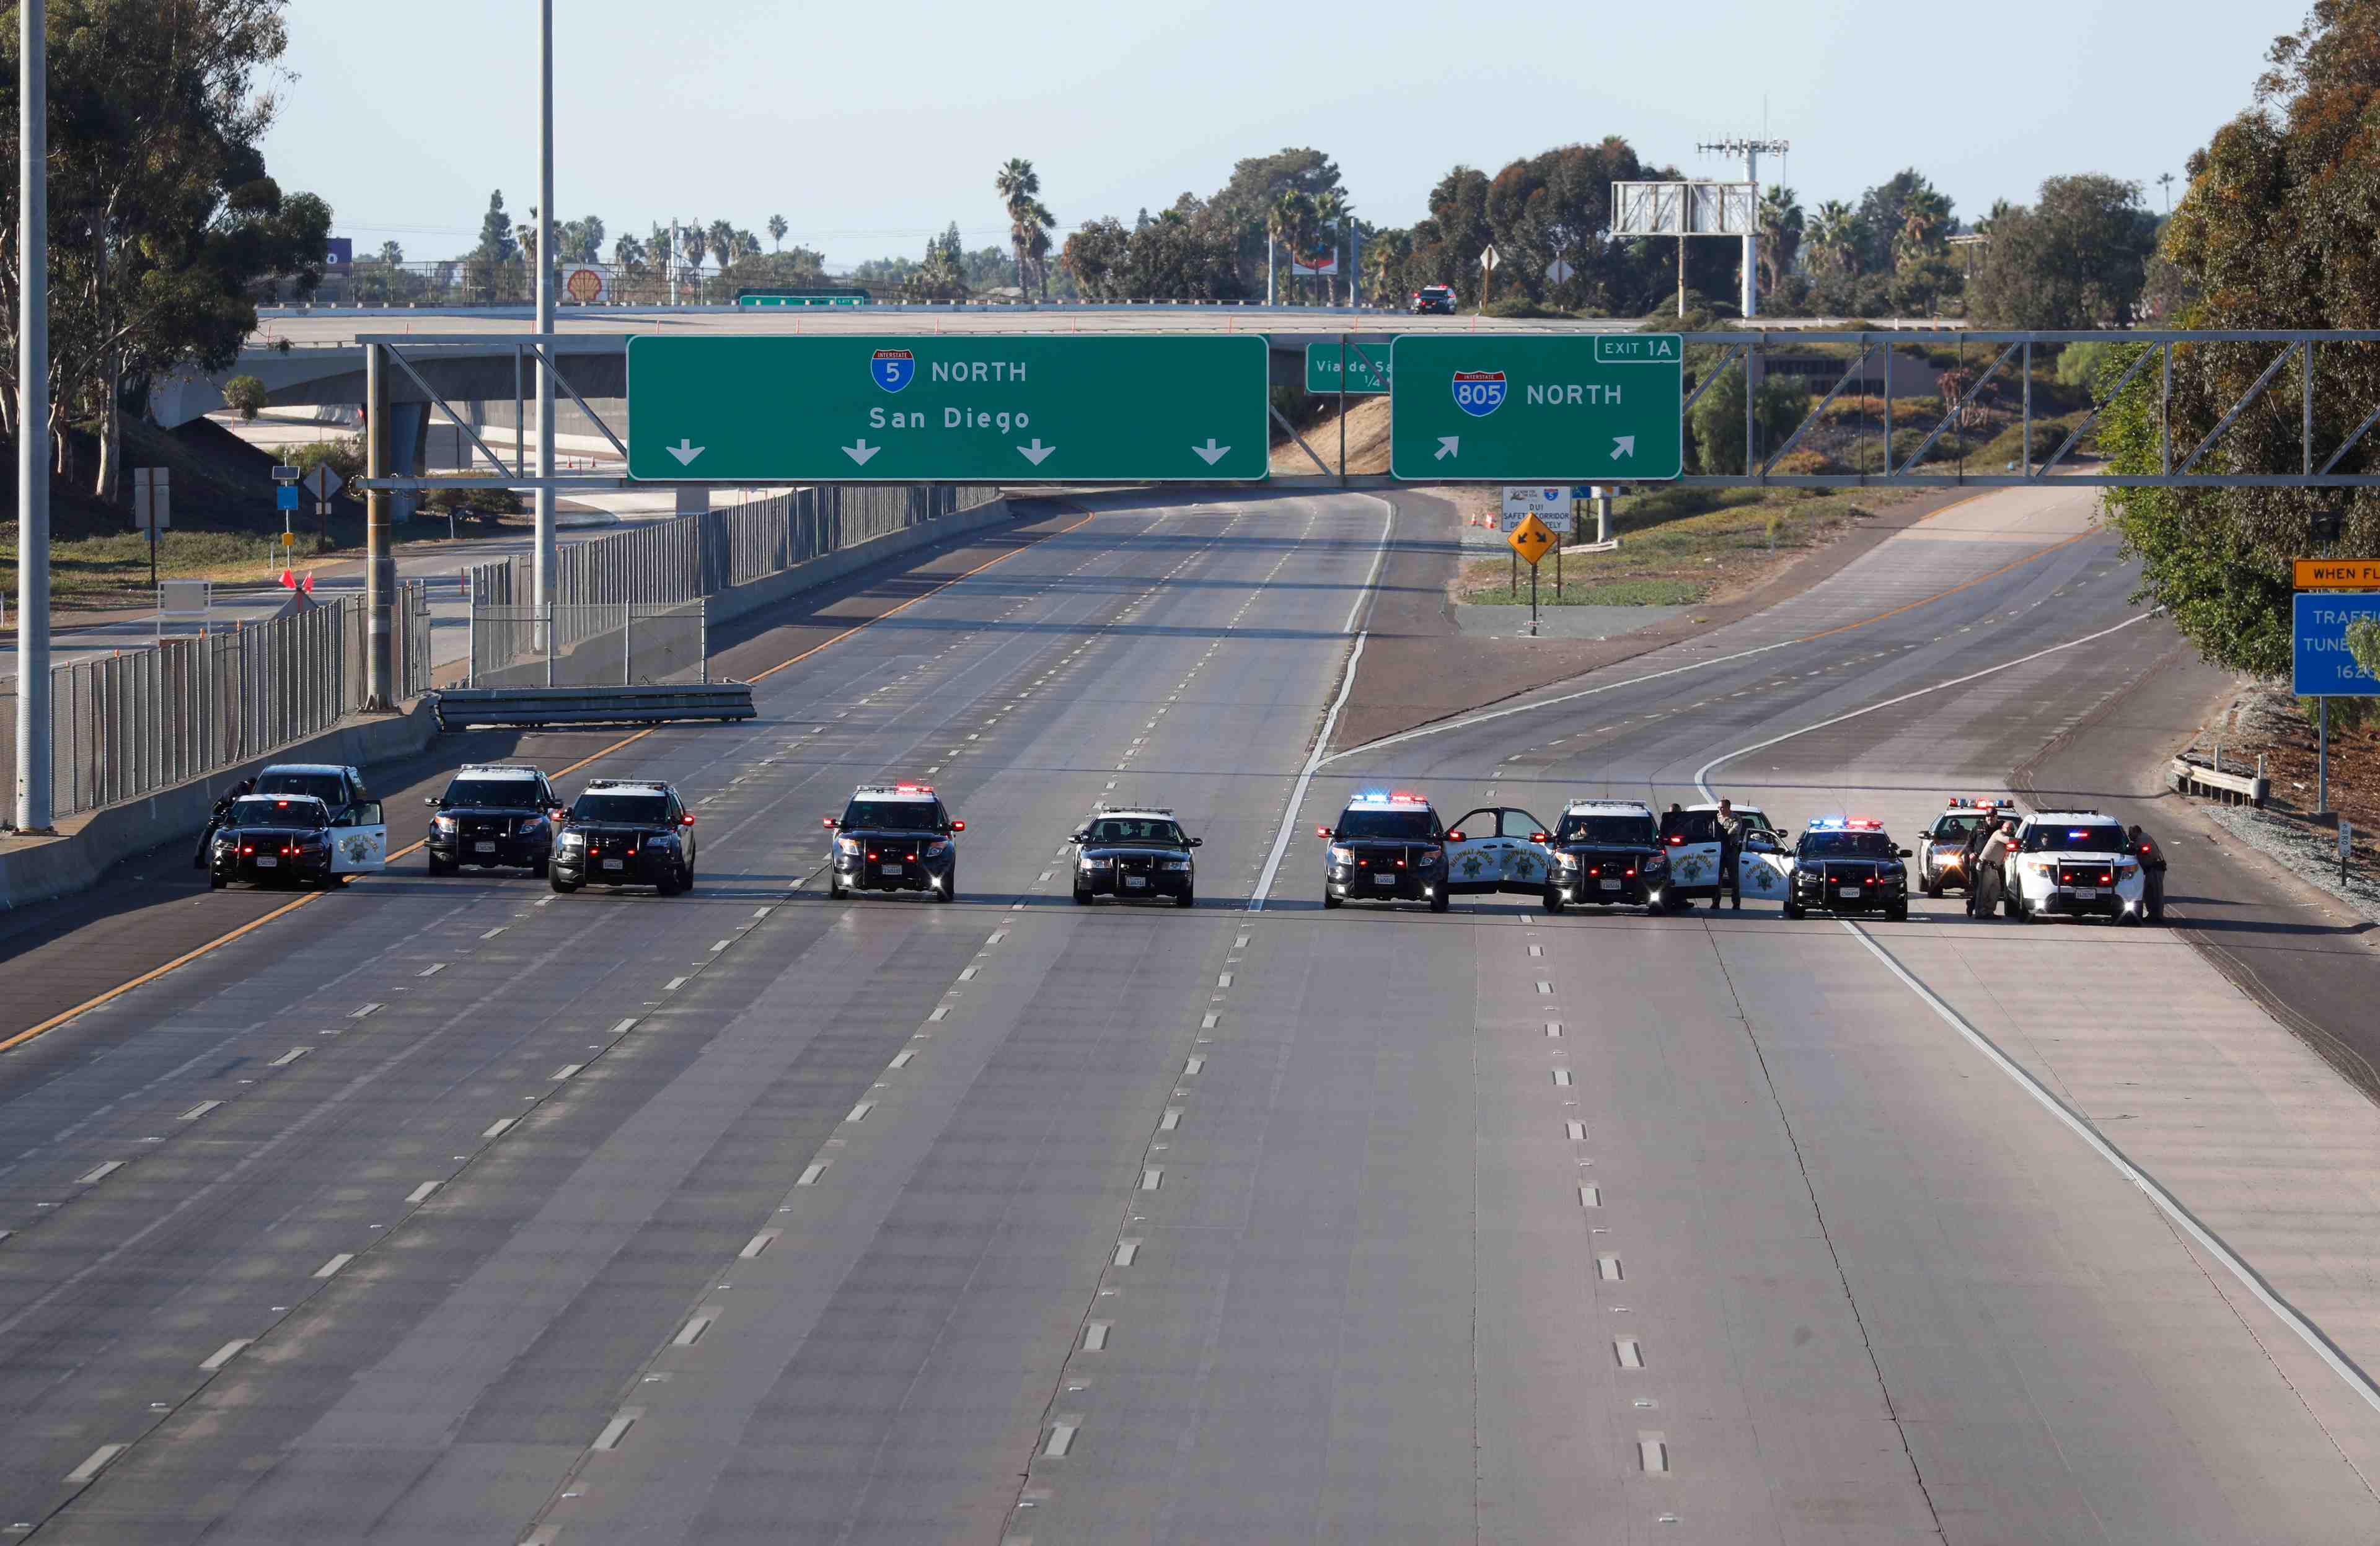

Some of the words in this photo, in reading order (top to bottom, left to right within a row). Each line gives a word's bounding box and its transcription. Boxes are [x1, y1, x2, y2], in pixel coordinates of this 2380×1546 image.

[1605, 343, 1639, 354] EXIT
[1649, 341, 1672, 356] 1A
[886, 362, 899, 382] 5
[932, 362, 1026, 382] NORTH
[1316, 360, 1341, 372] Via
[1349, 361, 1367, 372] de
[1458, 385, 1501, 405] 805
[1527, 385, 1621, 405] NORTH
[869, 407, 925, 428] San
[944, 407, 1029, 434] Diego
[2314, 568, 2356, 579] WHEN
[2363, 568, 2380, 579] FL
[2312, 610, 2380, 625] TRAFFI
[2303, 638, 2351, 652] TUNE
